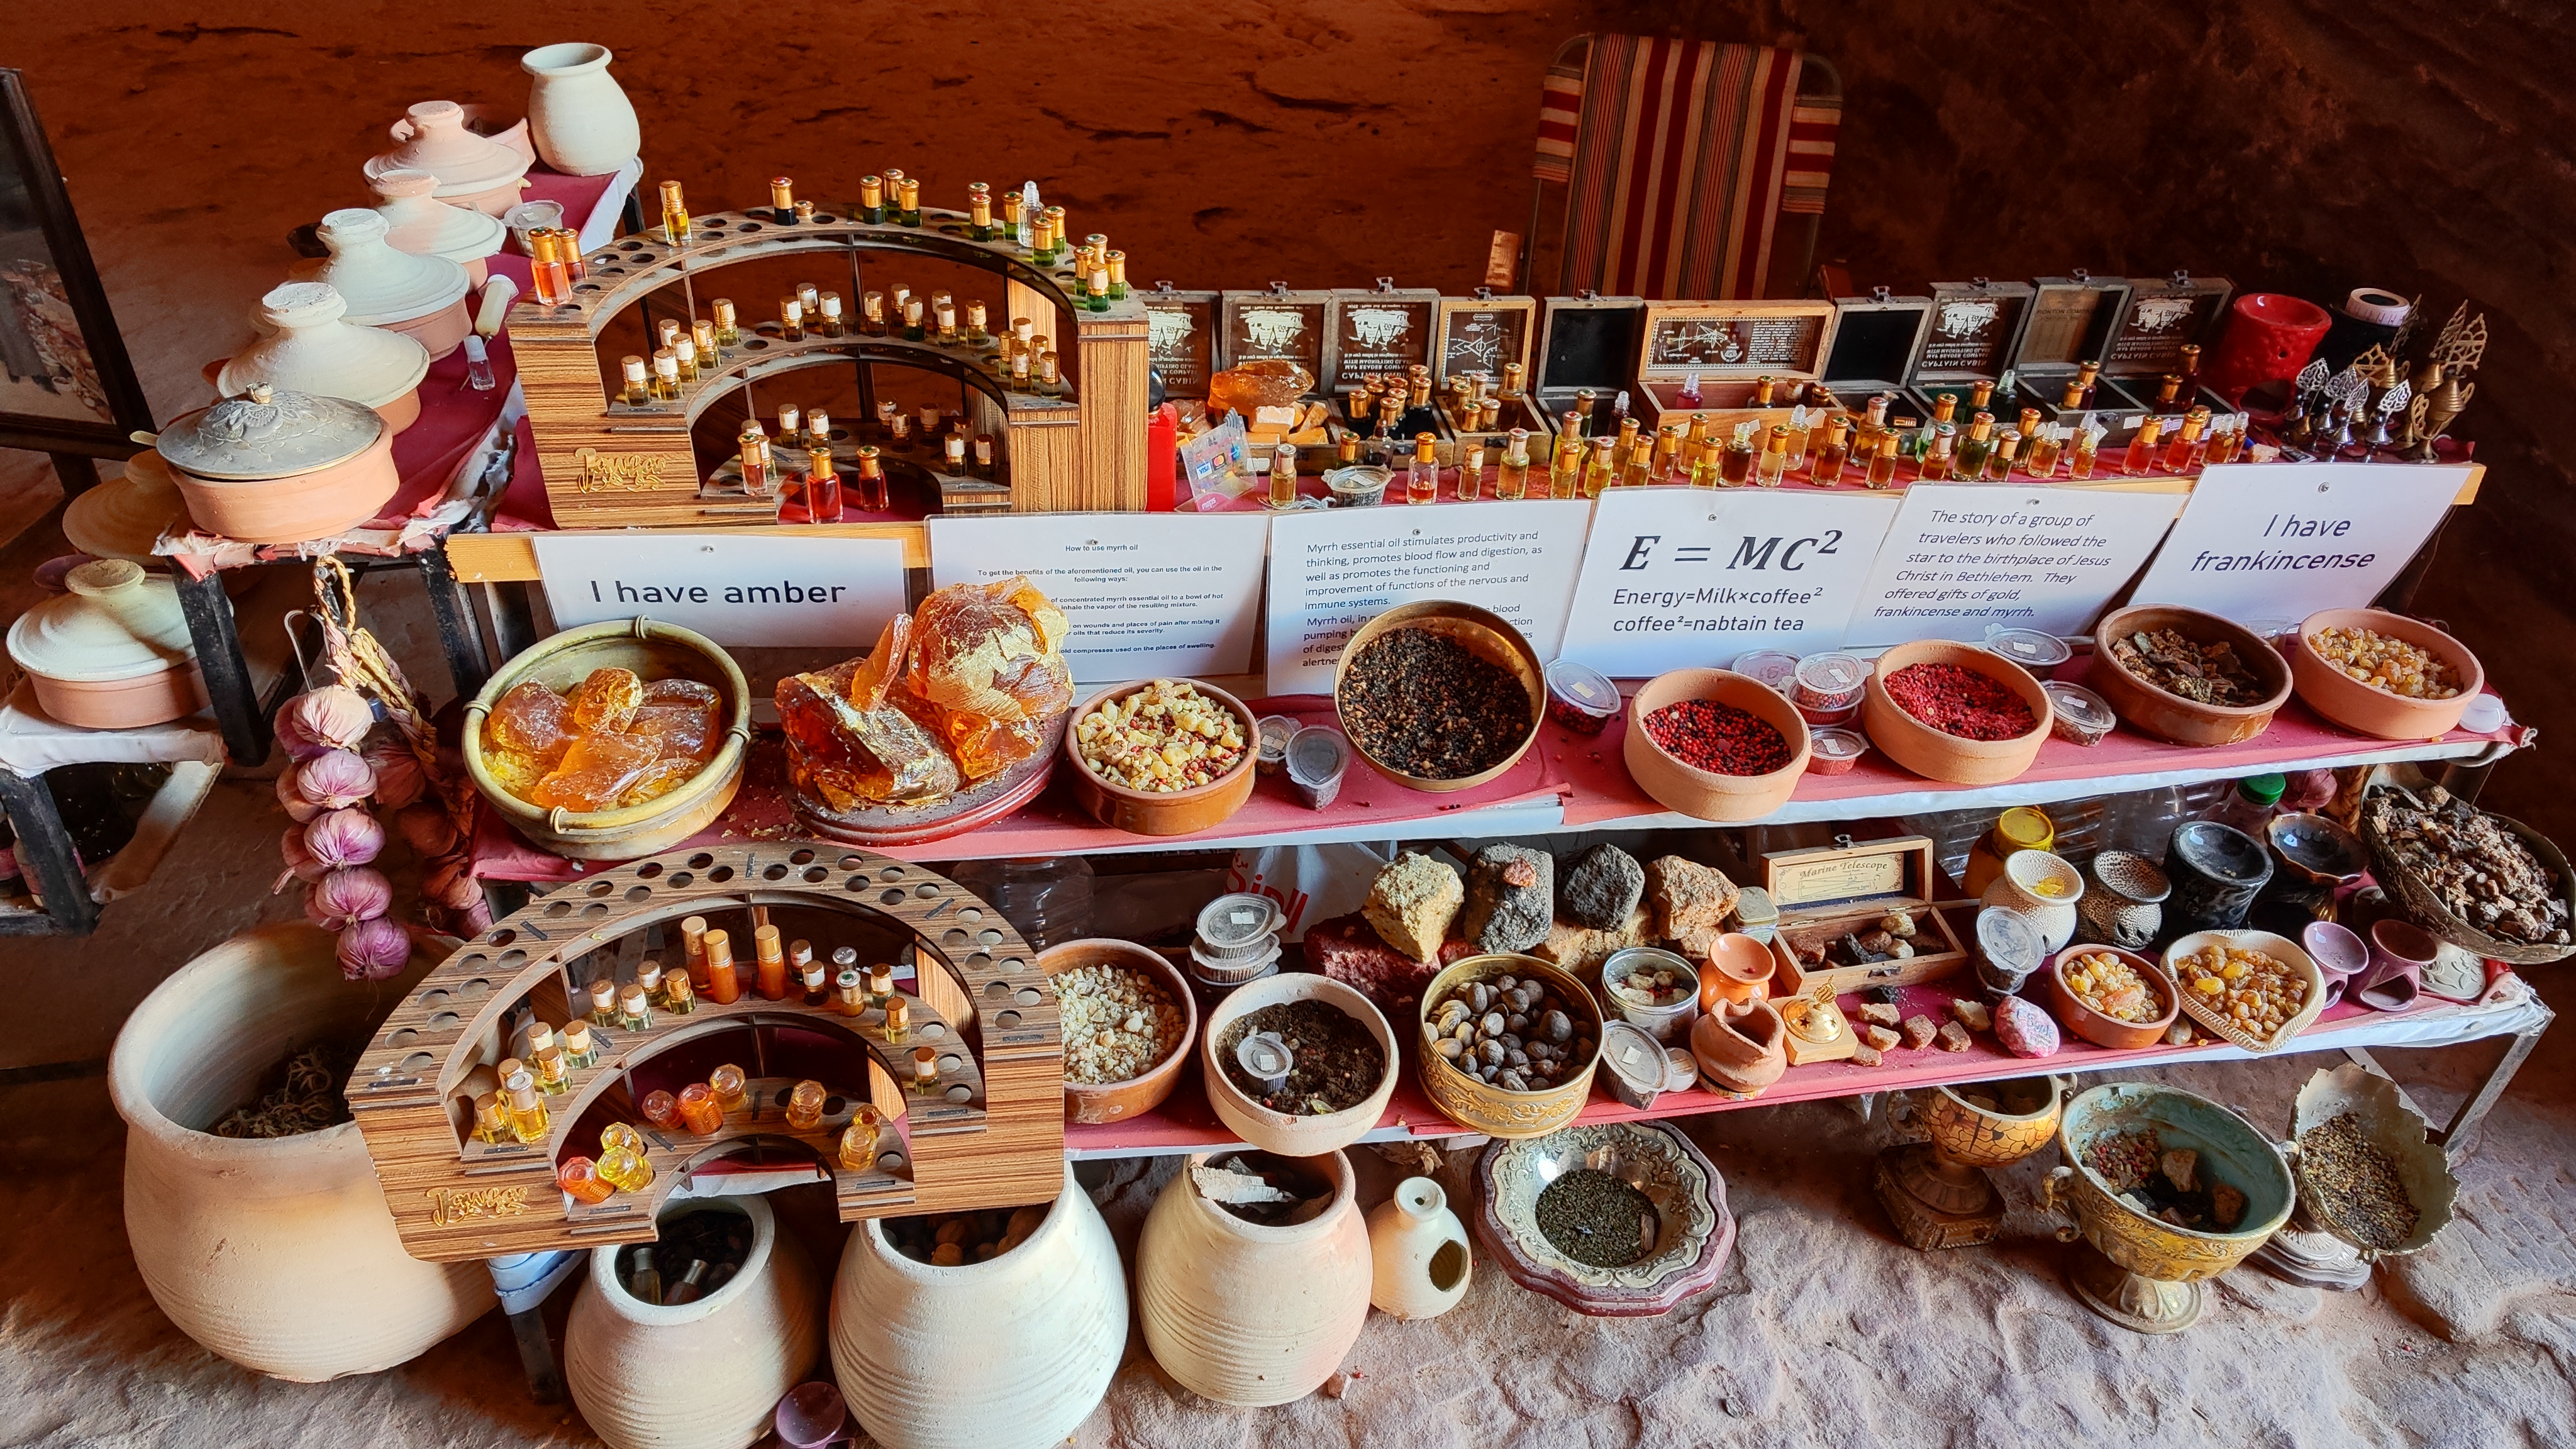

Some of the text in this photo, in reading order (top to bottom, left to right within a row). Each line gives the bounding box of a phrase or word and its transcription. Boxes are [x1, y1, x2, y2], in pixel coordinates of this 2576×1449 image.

[1199, 465, 1210, 475] VISA
[1931, 510, 2095, 529] The story of a group of
[2263, 514, 2351, 537] I have
[1307, 531, 1538, 555] Myrrh essential oil stimulates productivity and
[1919, 532, 2107, 547] travelers who followed the
[1306, 557, 1350, 567] thinking,
[1353, 554, 1401, 566] promotes
[1404, 550, 1433, 561] blood
[1435, 550, 1458, 559] flow
[1460, 548, 1479, 558] and
[1481, 546, 1528, 558] digestion,
[1619, 535, 1662, 570] E
[1674, 547, 1711, 562] =
[1906, 553, 2112, 567] star to the birthplace of Jesus
[2190, 550, 2376, 572] frankincense
[1306, 572, 1326, 581] well
[1342, 569, 1392, 581] promotes
[1393, 567, 1410, 577] the
[1413, 564, 1469, 575] functioning
[1472, 562, 1491, 571] and
[1896, 570, 2077, 585] Christ in Bethlehem. They
[591, 580, 847, 604] I have amber
[1306, 574, 1529, 597] improvement of functions of the nervous and
[1305, 597, 1391, 610] immune systems.
[1884, 589, 2021, 601] offered gifts of gold,
[1307, 616, 1337, 628] Myrrh
[1340, 614, 1355, 625] oil,
[1358, 612, 1367, 622] in
[1493, 604, 1520, 613] blood
[1874, 606, 2035, 619] frankincense and myrrh.
[1774, 616, 1804, 631] tea
[1303, 628, 1347, 641] pumping
[1302, 645, 1317, 653] of
[1302, 657, 1340, 667] alertne
[1799, 860, 1888, 880] Marine Telescope
